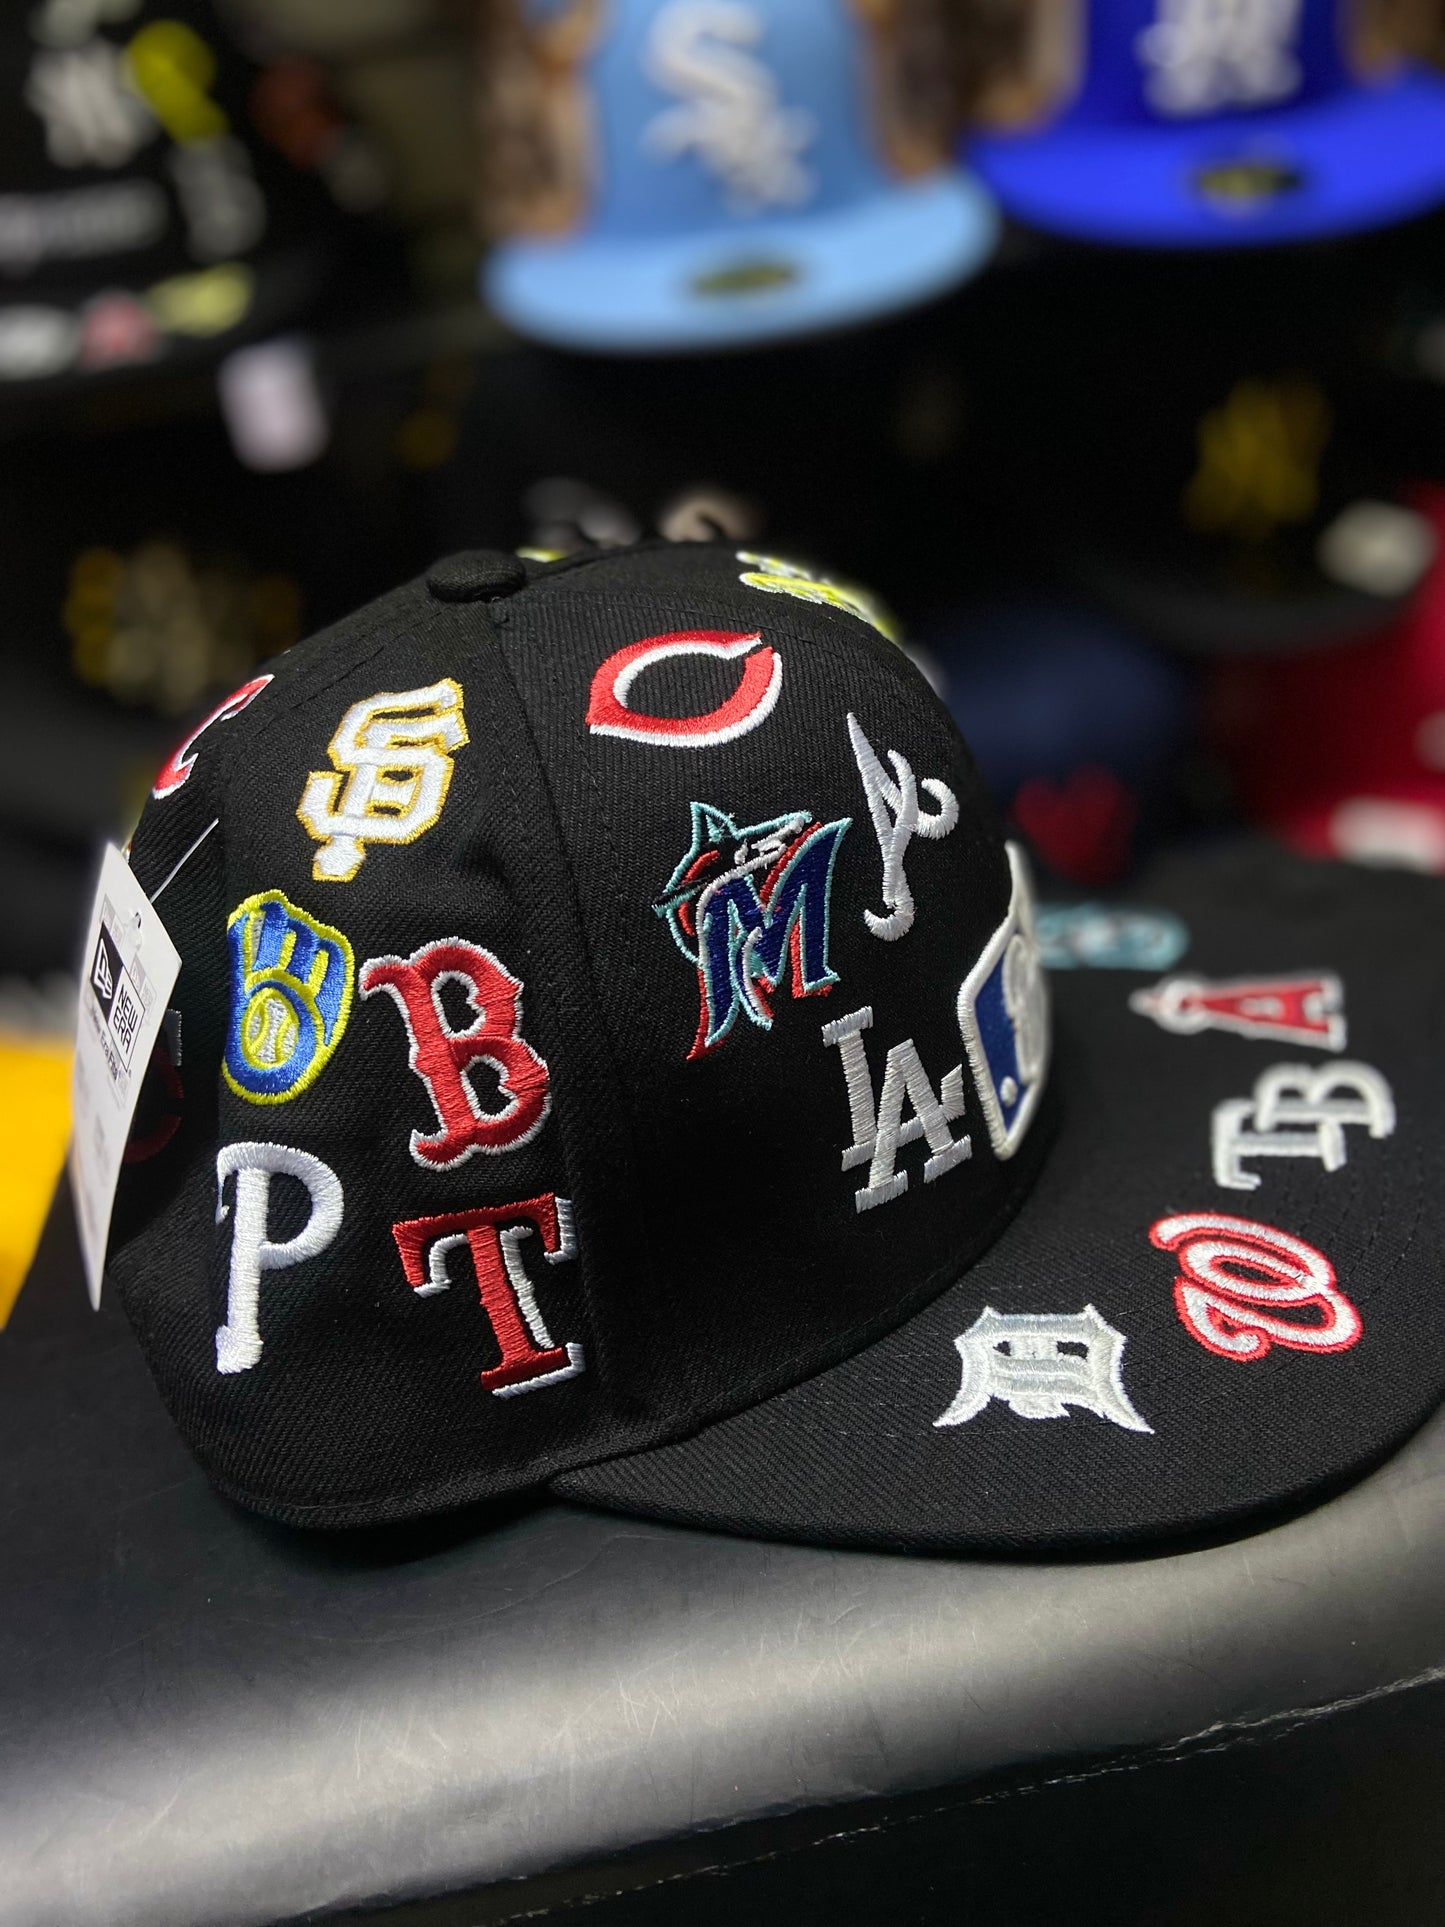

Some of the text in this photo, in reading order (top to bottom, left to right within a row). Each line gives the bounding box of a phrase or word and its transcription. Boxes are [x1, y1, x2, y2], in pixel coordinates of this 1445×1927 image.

[296, 678, 472, 883] SF
[588, 630, 783, 748] C
[113, 1005, 132, 1055] ERA
[117, 983, 139, 1033] NEW
[358, 937, 552, 1173] B
[821, 1005, 973, 1214] LA
[1210, 1060, 1397, 1191] TB
[216, 1141, 345, 1374] P
[391, 1191, 586, 1400] T
